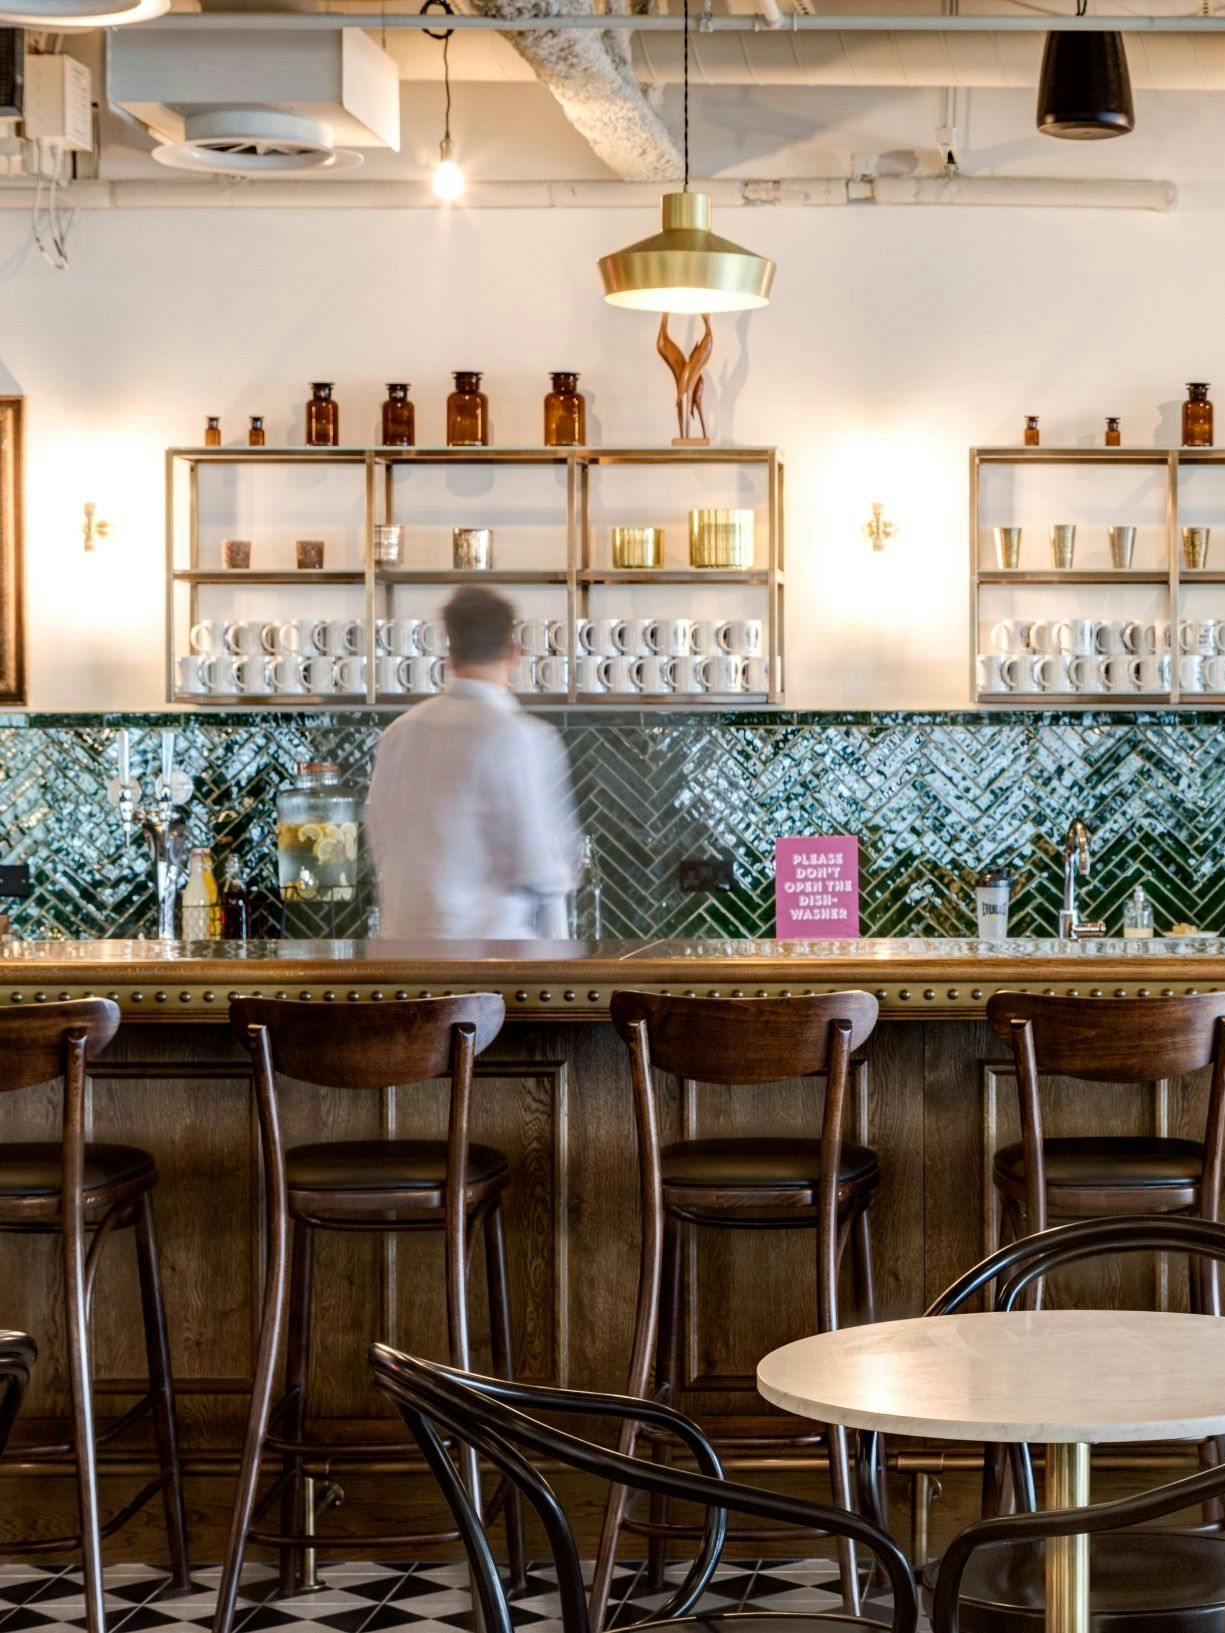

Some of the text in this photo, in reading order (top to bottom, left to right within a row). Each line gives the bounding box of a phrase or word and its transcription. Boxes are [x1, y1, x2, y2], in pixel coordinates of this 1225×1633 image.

[792, 853, 844, 865] PLEASE
[796, 867, 841, 879] DON'T
[784, 880, 853, 893] OPEN THE
[799, 894, 838, 906] DISH-
[790, 908, 848, 920] WASHER
